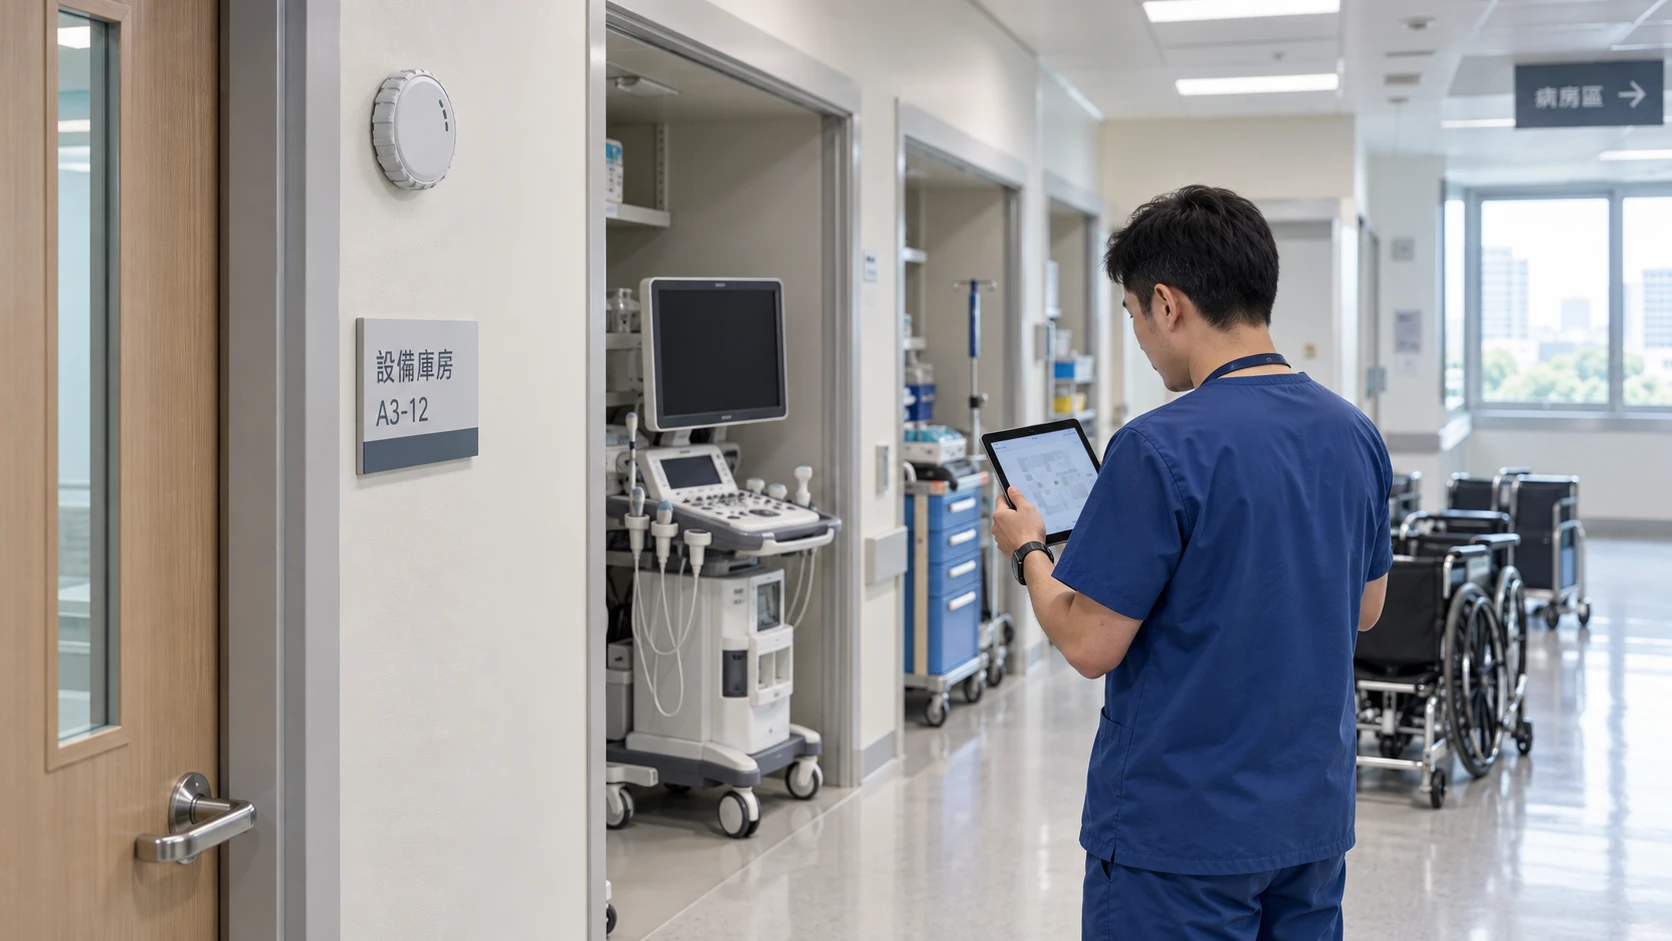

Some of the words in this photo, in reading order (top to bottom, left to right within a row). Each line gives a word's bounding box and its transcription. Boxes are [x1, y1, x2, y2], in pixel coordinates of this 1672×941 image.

[1535, 85, 1604, 109] 病房區
[376, 349, 453, 384] 設備庫房
[376, 396, 428, 427] A3-12
